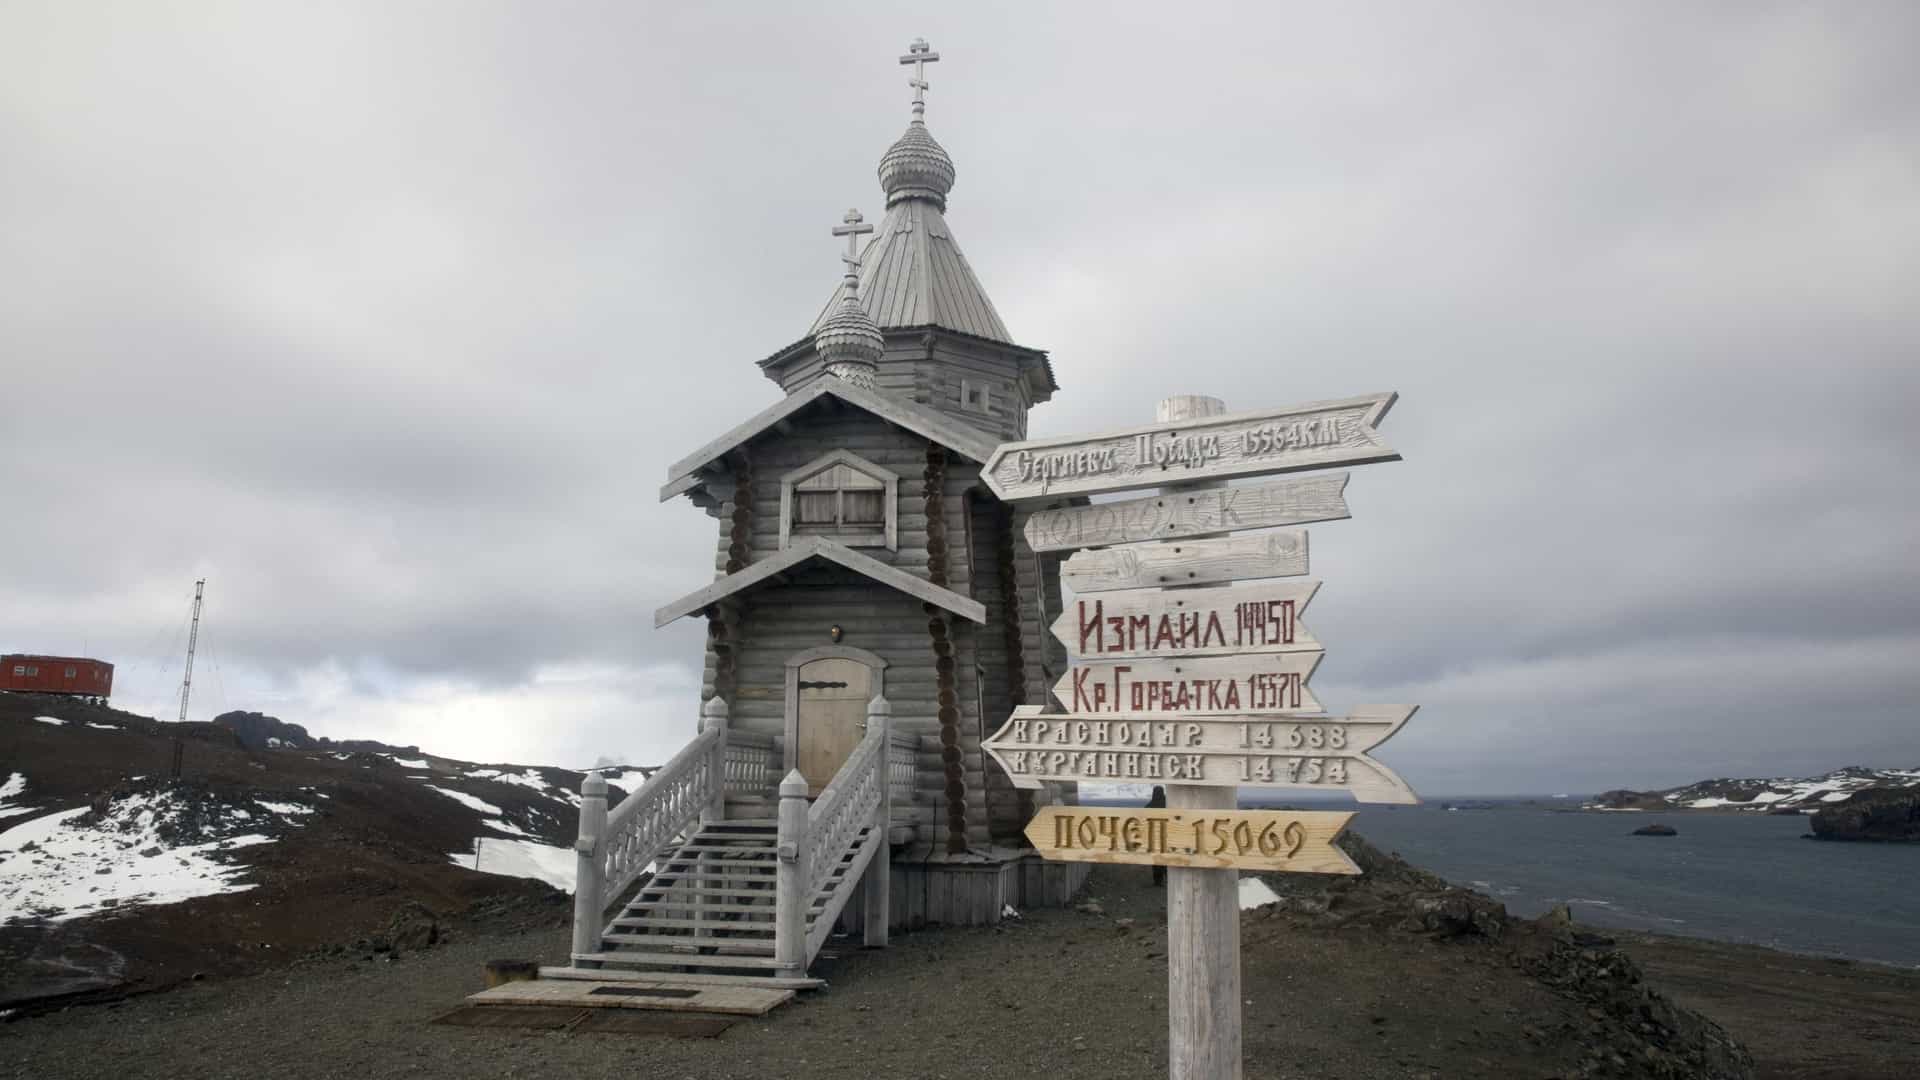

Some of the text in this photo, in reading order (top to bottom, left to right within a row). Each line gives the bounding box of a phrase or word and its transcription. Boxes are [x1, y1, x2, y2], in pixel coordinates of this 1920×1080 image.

[1234, 600, 1296, 647] 14450
[1248, 672, 1301, 709] 15570
[1239, 723, 1274, 749] 14
[1288, 724, 1347, 749] 688
[1239, 756, 1274, 783] 14
[1288, 757, 1348, 784] 754
[1192, 818, 1307, 859] 15069
